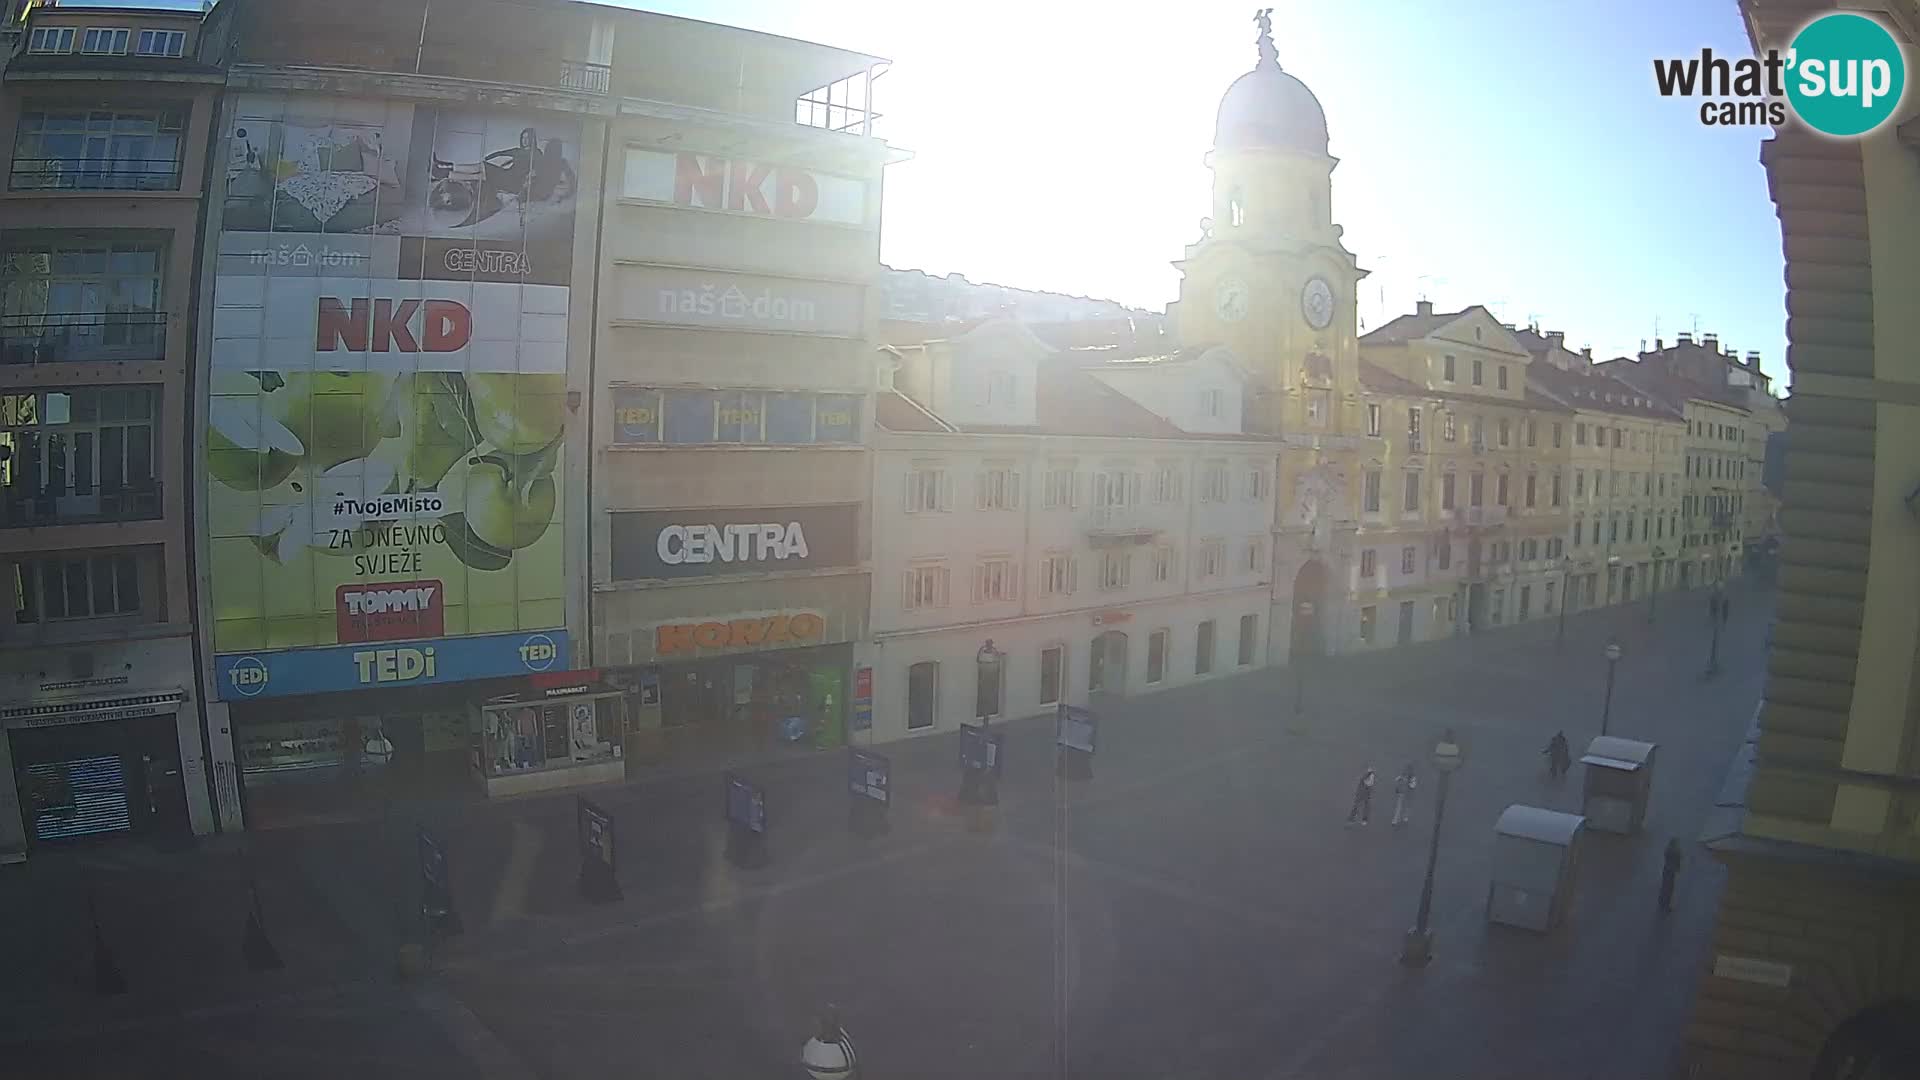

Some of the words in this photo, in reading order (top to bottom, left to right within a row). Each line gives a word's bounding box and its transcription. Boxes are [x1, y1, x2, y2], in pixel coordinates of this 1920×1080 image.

[674, 152, 819, 219] NKD
[315, 244, 361, 267] dom
[444, 248, 532, 274] CENTRA
[658, 283, 717, 316] naš
[753, 288, 816, 321] dom
[315, 296, 473, 353] NKD
[333, 496, 442, 517] #TvojeMisto
[329, 529, 354, 550] ZA
[363, 524, 447, 548] DNEVNO
[657, 521, 809, 565] CENTRA
[355, 549, 423, 576] SVJEŽE
[345, 587, 435, 616] TOMMY
[655, 612, 824, 655] KORZO
[354, 647, 436, 683] TEDi
[519, 643, 557, 662] TEDi
[229, 665, 269, 687] TEDi
